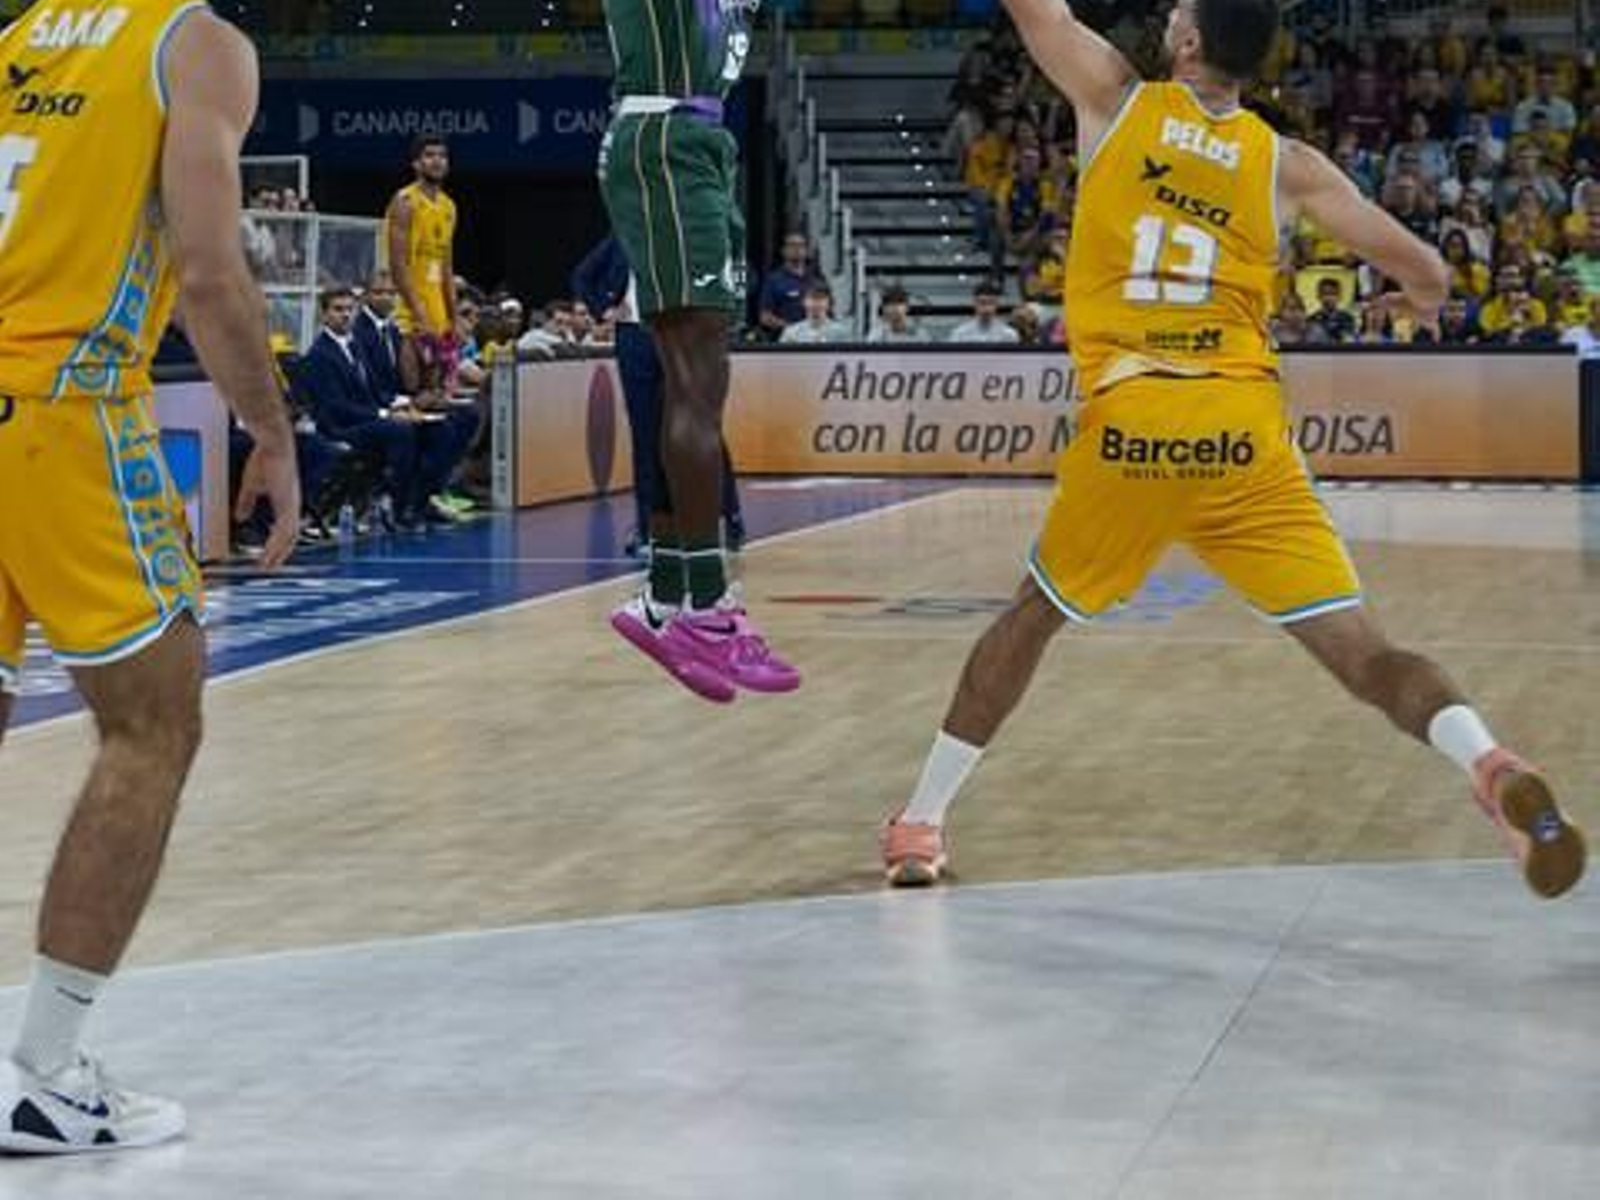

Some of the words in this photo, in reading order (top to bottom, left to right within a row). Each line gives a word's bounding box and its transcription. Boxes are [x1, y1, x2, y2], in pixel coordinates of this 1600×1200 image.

[333, 105, 490, 134] CANARAGUA
[553, 107, 606, 134] CAN
[1155, 185, 1232, 226] DISA
[1120, 213, 1219, 306] 13
[822, 362, 966, 401] Ahorra
[982, 373, 1024, 400] en
[1039, 368, 1086, 402] DI
[813, 421, 886, 453] con
[902, 412, 940, 453] la
[956, 421, 1035, 463] app
[1288, 415, 1394, 456] DISA
[1100, 425, 1254, 466] Barceló
